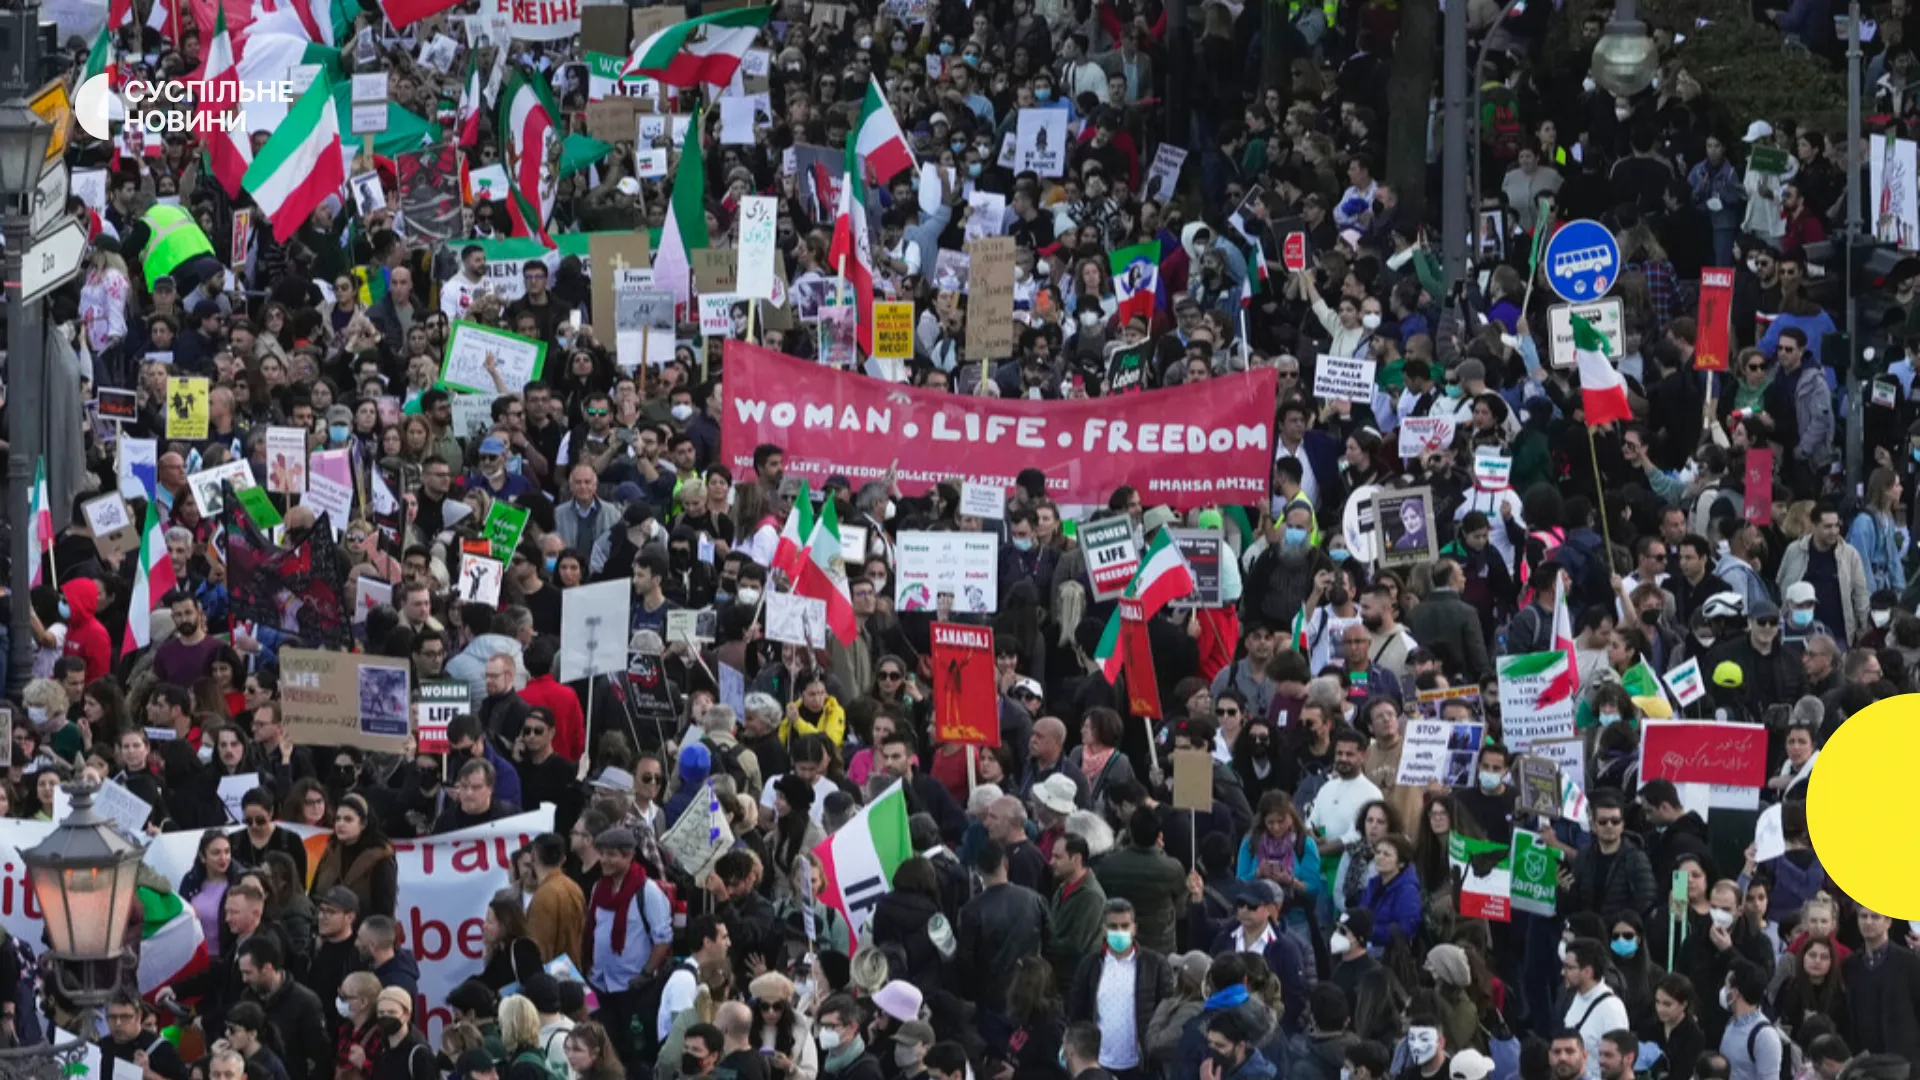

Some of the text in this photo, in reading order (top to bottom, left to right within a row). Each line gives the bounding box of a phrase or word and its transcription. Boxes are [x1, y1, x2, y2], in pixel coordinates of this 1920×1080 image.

[42, 252, 55, 274] Zoo
[879, 331, 908, 340] MUSS
[734, 397, 1267, 453] WOMAN LIFE FREEDOM
[1149, 477, 1212, 492] #MAHSA
[1086, 523, 1128, 544] WOMEN
[1098, 546, 1127, 564] LIFE
[1095, 564, 1138, 583] FREEDOM
[934, 628, 989, 649] SANANDAJ
[421, 684, 468, 696] WOMEN
[429, 707, 459, 721] LIFE
[419, 730, 448, 741] FREE
[1416, 725, 1441, 735] STOP
